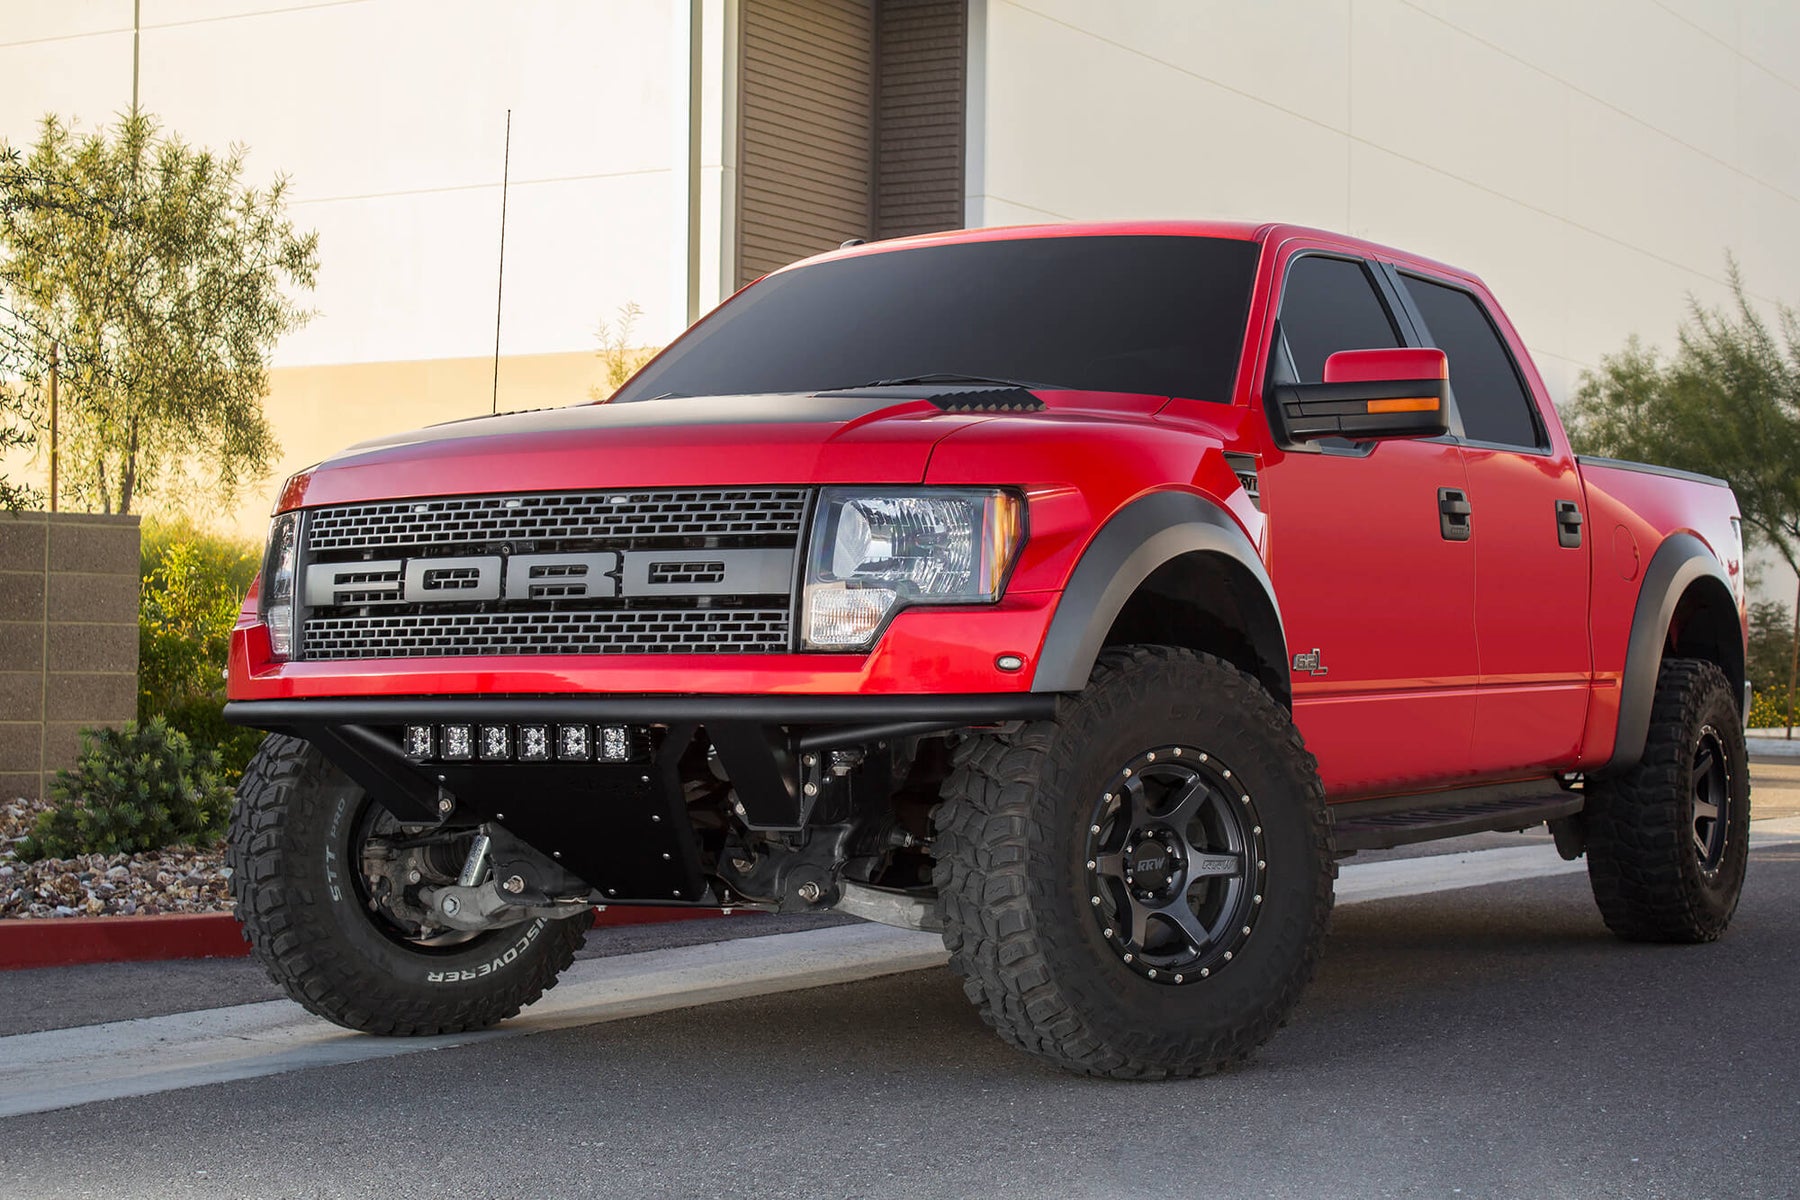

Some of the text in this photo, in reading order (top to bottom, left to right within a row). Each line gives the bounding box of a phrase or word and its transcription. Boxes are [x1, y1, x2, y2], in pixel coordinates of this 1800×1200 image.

[304, 547, 795, 608] FORD
[325, 798, 346, 902] STT PRO
[427, 917, 548, 982] ISCOVERER
